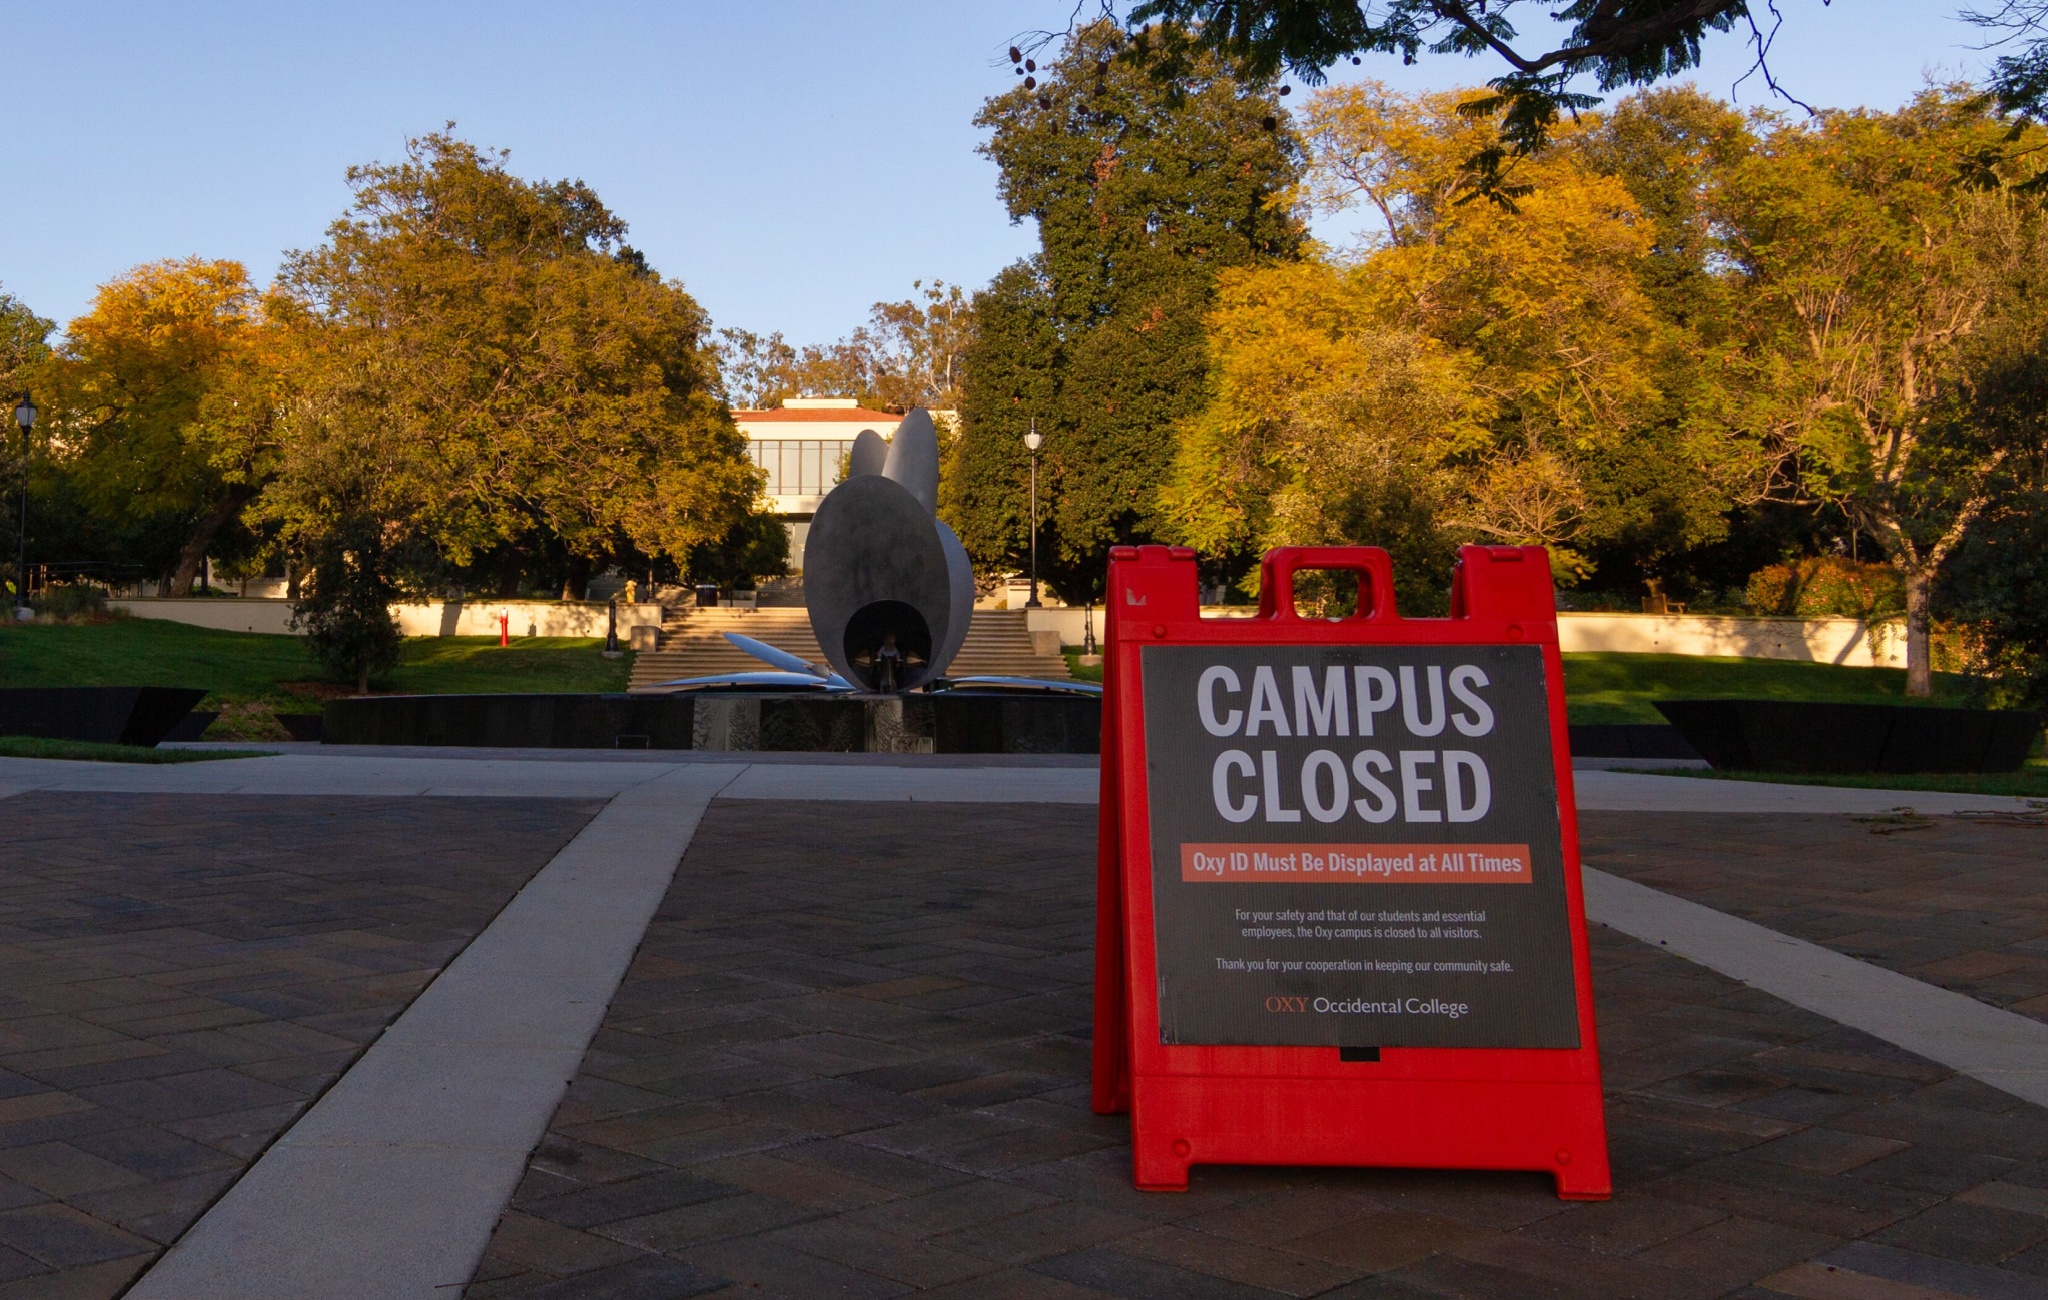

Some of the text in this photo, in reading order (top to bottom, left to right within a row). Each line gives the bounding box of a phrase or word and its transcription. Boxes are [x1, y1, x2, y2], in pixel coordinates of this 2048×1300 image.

[1197, 664, 1495, 737] CAMPUS
[1212, 749, 1492, 824] CLOSED
[1193, 852, 1522, 877] Oxy ID Must Be Displayed at All Times
[1235, 909, 1486, 923] For your safety and that of our students and essential
[1241, 925, 1482, 941] employees, the Oxy campus is closed to all visitors.
[1215, 957, 1514, 975] Thank you for your cooperation in keeping our community safe.
[1265, 996, 1469, 1019] OXY Occidental College
